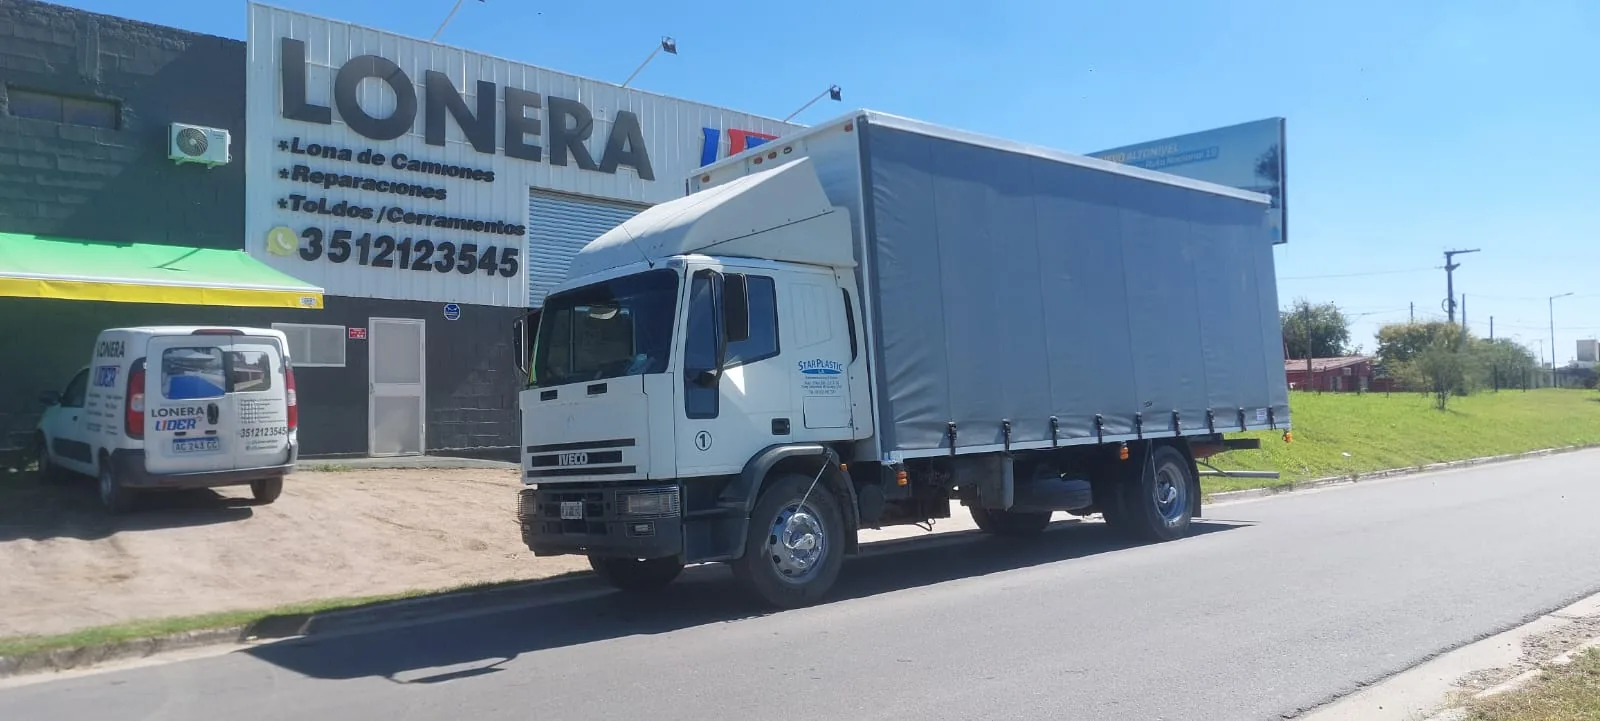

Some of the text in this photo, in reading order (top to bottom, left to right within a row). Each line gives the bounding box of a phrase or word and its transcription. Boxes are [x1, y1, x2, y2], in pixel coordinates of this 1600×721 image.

[282, 38, 655, 181] LONERA
[357, 149, 386, 166] de
[391, 153, 495, 183] Camiones
[299, 227, 519, 278] 3512123545
[151, 406, 205, 418] LONERA
[240, 427, 287, 438] 3512123545
[699, 433, 706, 448] 1
[558, 452, 589, 466] IVECO
